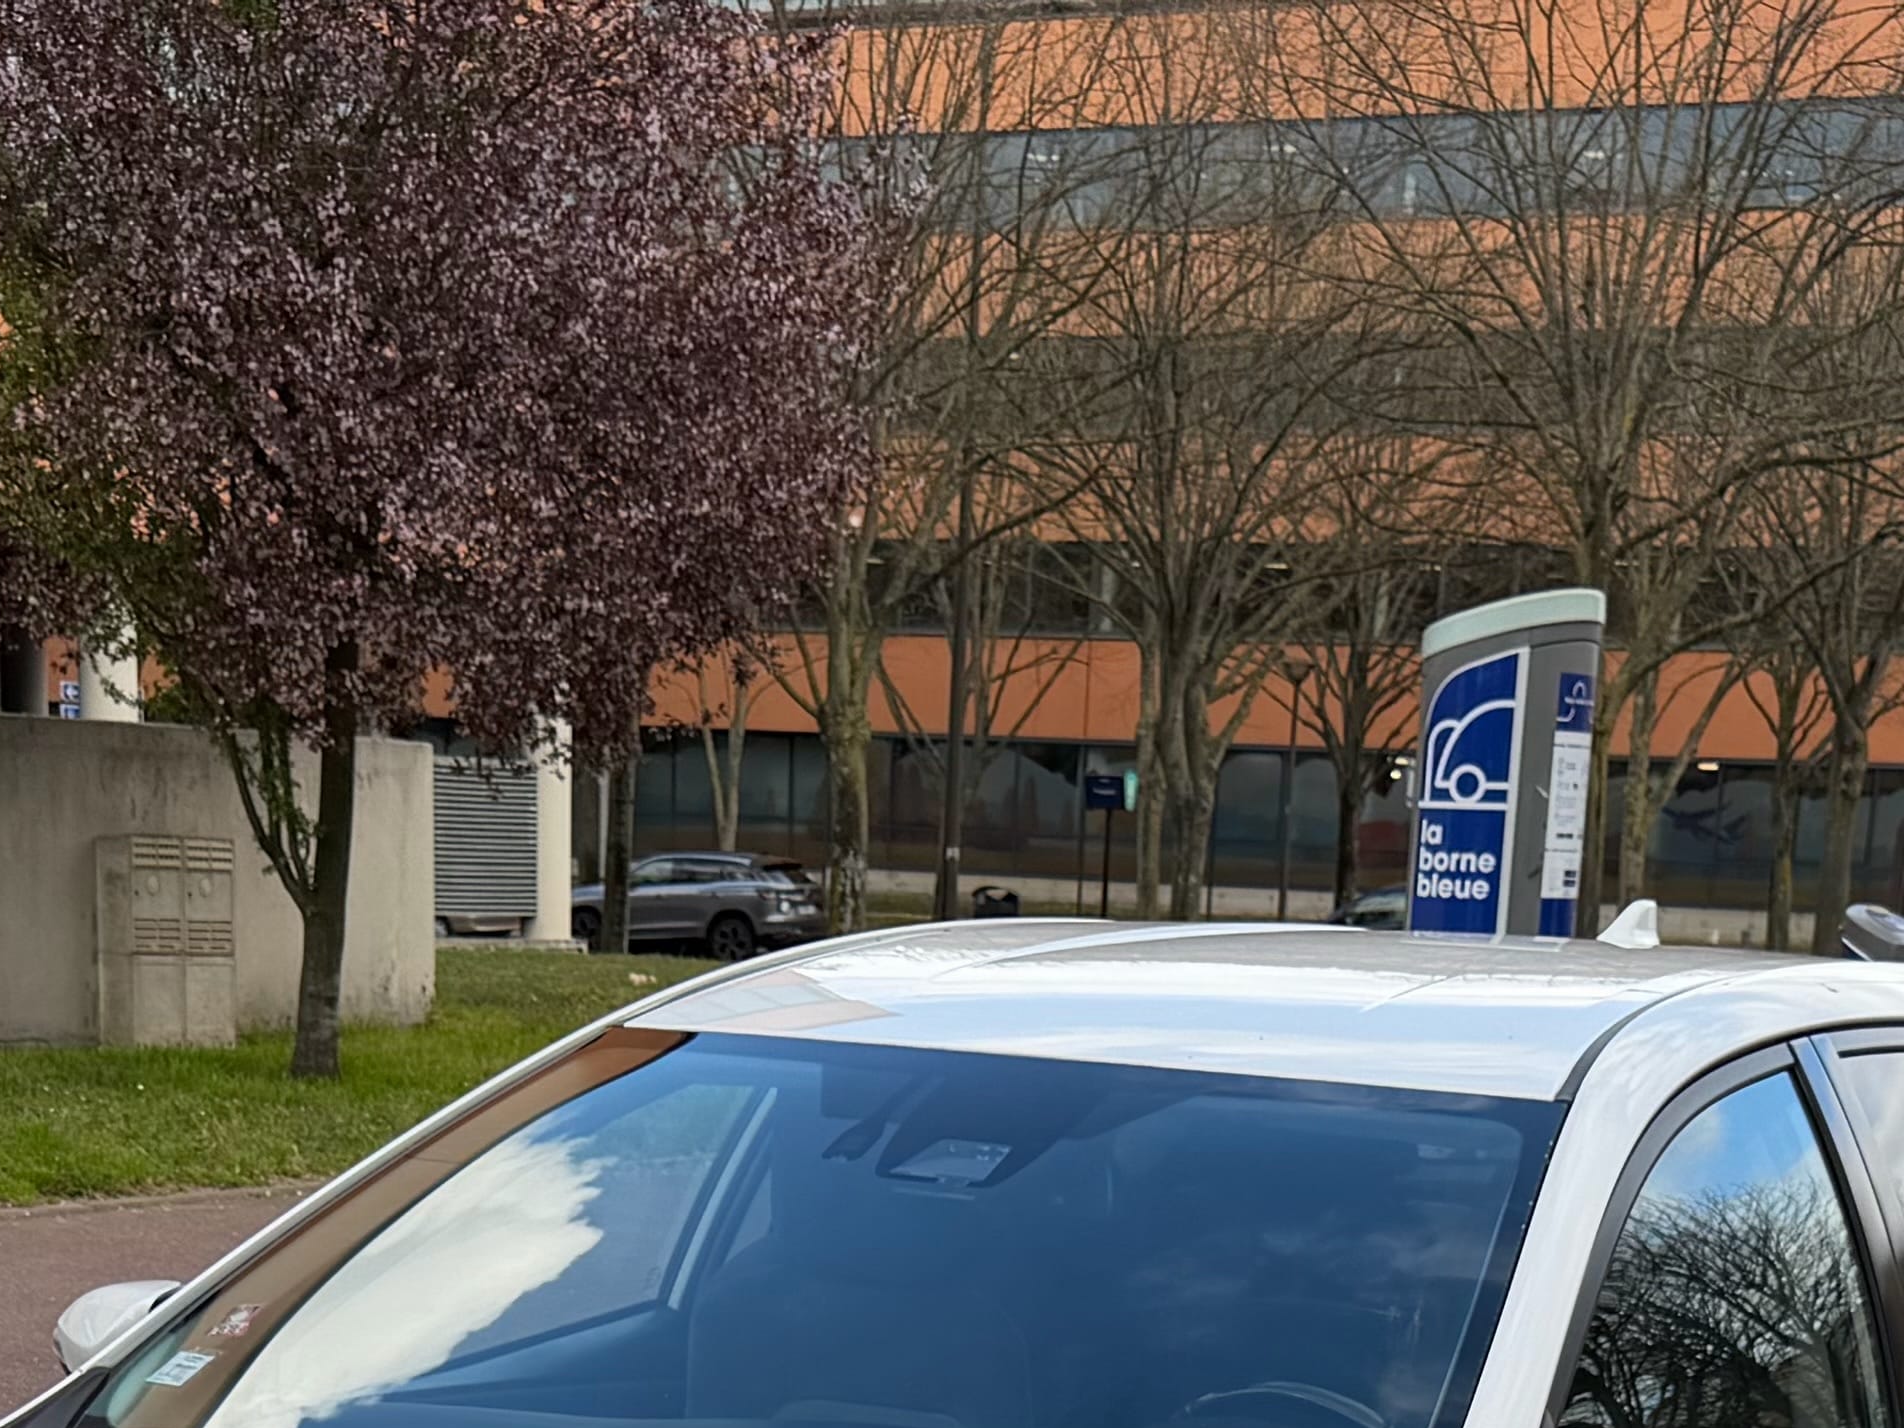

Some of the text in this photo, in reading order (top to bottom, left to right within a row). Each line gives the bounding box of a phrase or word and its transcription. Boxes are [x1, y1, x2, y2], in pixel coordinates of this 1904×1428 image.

[1420, 818, 1443, 846] la
[1419, 845, 1496, 874] borne
[1416, 871, 1490, 900] bleue
